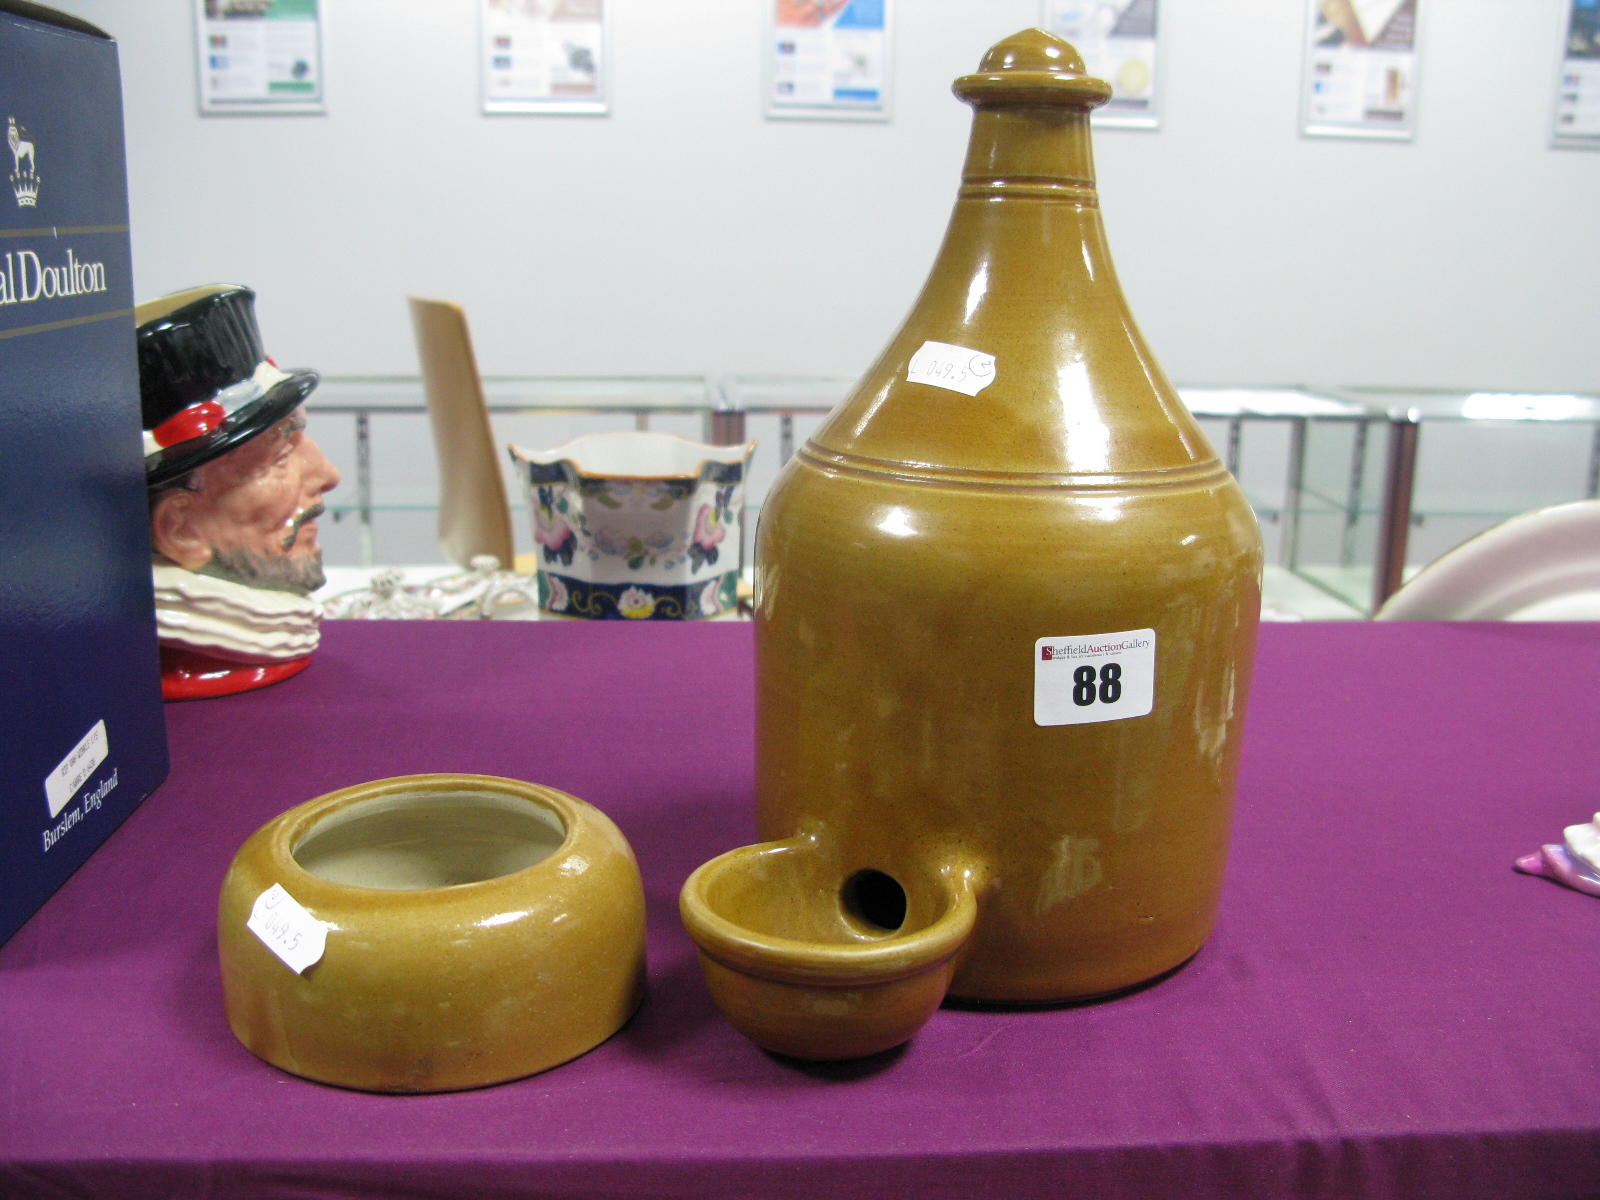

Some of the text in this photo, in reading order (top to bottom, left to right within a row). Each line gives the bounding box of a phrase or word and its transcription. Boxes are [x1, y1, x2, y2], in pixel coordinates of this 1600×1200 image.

[17, 248, 107, 302] Doulton
[1072, 662, 1122, 707] 88
[42, 766, 119, 853] Burslem, England
